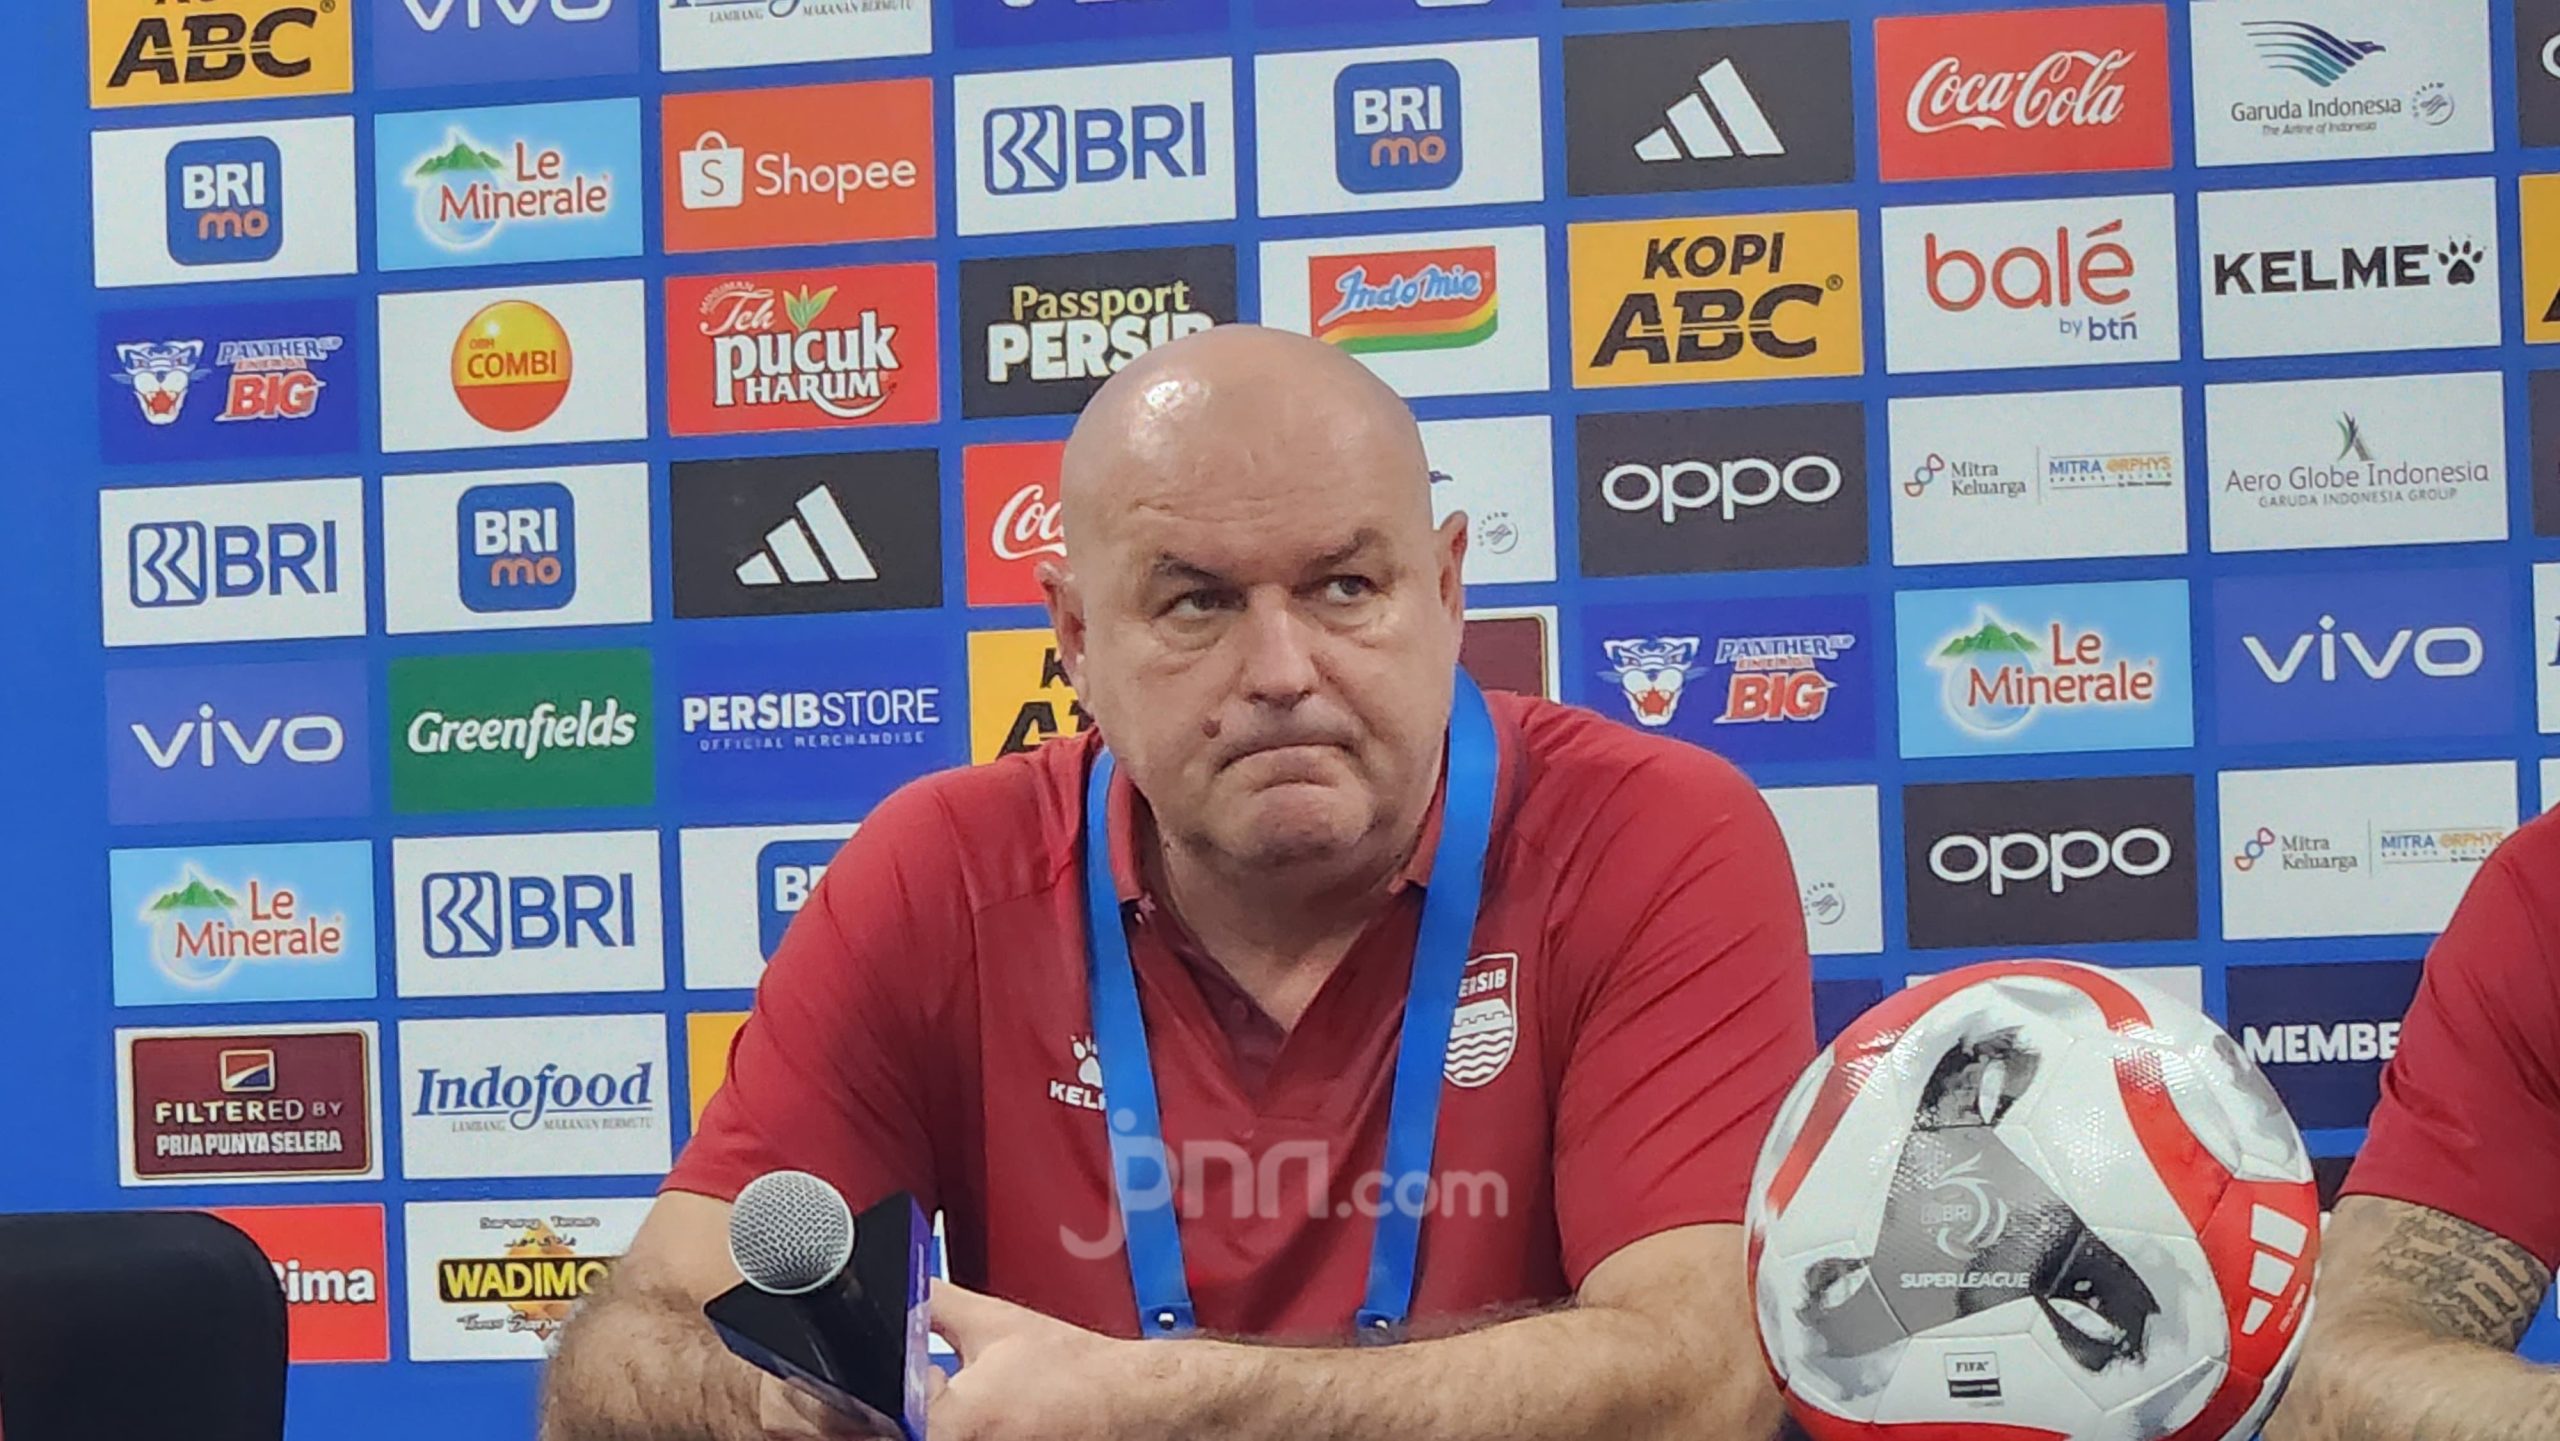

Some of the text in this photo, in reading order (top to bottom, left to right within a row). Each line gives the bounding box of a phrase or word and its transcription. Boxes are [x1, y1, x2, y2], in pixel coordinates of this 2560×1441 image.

[107, 6, 317, 89] ABC
[1353, 85, 1442, 135] BRI
[1906, 49, 2137, 133] Coca-Cola
[2231, 99, 2302, 122] Garuda
[2308, 97, 2402, 119] Indonesia
[515, 142, 560, 182] Le
[1074, 101, 1206, 184] BRI
[1371, 134, 1447, 167] mo
[181, 162, 264, 210] BRI
[755, 154, 917, 203] Shopee
[439, 177, 606, 223] Minerale
[199, 213, 269, 240] mo
[1642, 232, 1785, 280] KOPI
[1925, 218, 2134, 312] balé
[2212, 243, 2432, 296] KELME
[700, 289, 776, 336] Teh
[1012, 280, 1190, 325] Passport
[1589, 283, 1824, 369] ABC
[2059, 317, 2083, 338] by
[216, 337, 325, 366] PANTHER
[467, 350, 557, 379] COMBI
[224, 371, 322, 421] BIG
[746, 371, 886, 411] HARUM
[1951, 461, 1998, 477] Mitra
[2049, 459, 2102, 474] MITRA
[2225, 461, 2489, 492] Aero Globe Indonesia
[1602, 455, 1842, 523] oppo
[1951, 479, 2026, 498] Keluarga
[2259, 487, 2457, 508] GARUDA INDONESIA GROUP
[474, 508, 557, 557] BRI
[214, 520, 337, 598] BRI
[491, 557, 561, 586] mo
[1715, 636, 1835, 664] PANTHER
[2051, 623, 2101, 667] Le
[2243, 614, 2484, 684] vivo
[1726, 670, 1830, 722] BIG
[1968, 661, 2154, 708] Minerale
[131, 703, 343, 769] vivo
[407, 698, 636, 760] Greenfields
[700, 731, 924, 751] OFFICIAL MERCHANDISE
[1928, 826, 2172, 895] oppo
[2282, 835, 2330, 851] Mitra
[2282, 853, 2357, 872] Keluarga
[2381, 834, 2435, 849] MITRA
[250, 881, 294, 921] Le
[510, 872, 635, 949] BRI
[175, 917, 340, 959] Minerale
[1458, 968, 1507, 998] ERSIB
[2243, 1021, 2401, 1064] MEMBE
[155, 1100, 343, 1124] FILTERED BY
[411, 1061, 653, 1131] Indofood
[1050, 1080, 1106, 1111] KEL
[271, 1129, 343, 1153] SELERA
[444, 1260, 609, 1299] WADIMO
[1956, 1361, 1986, 1373] FIFA
